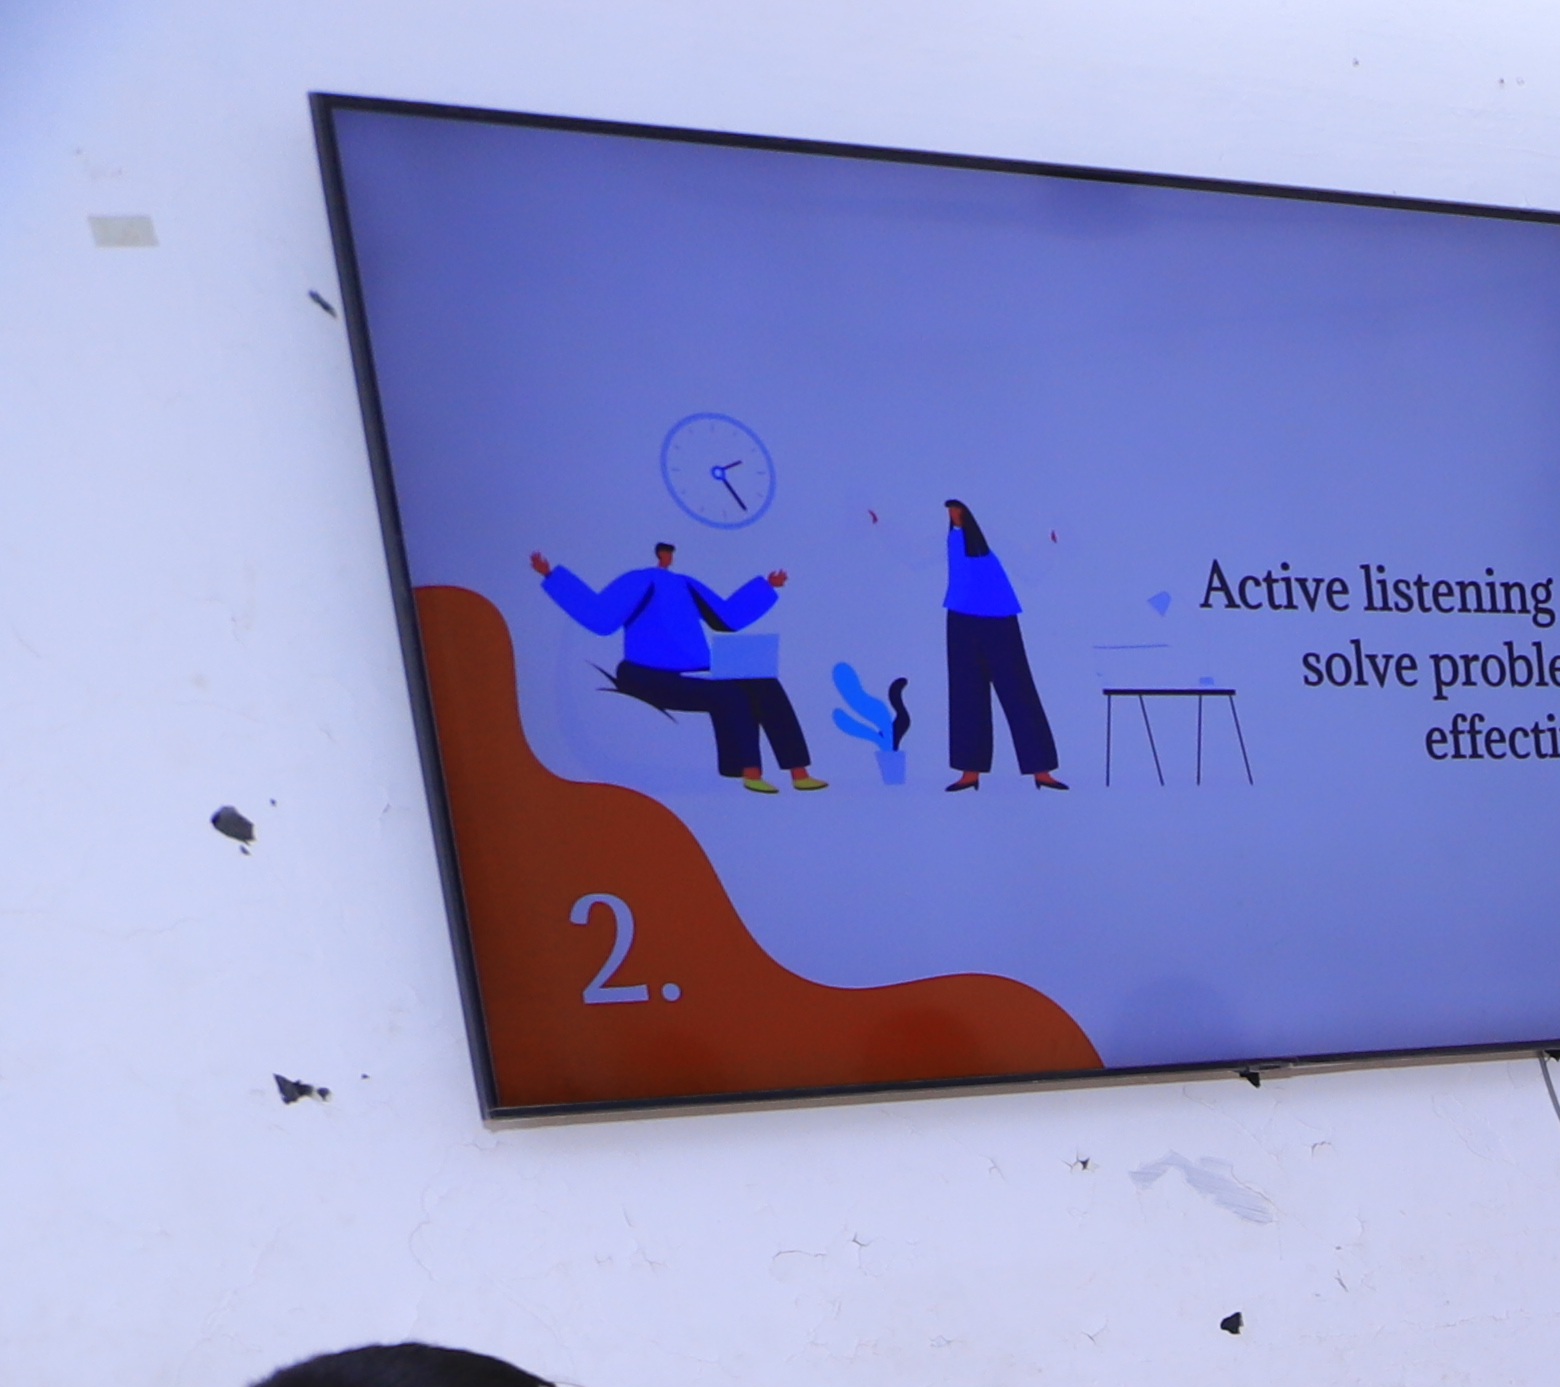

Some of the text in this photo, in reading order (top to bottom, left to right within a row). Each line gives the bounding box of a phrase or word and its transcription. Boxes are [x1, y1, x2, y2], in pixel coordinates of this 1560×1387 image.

[1200, 559, 1349, 612] Active
[1359, 564, 1556, 628] listening
[1303, 639, 1418, 688] solve
[569, 893, 681, 1004] 2.
